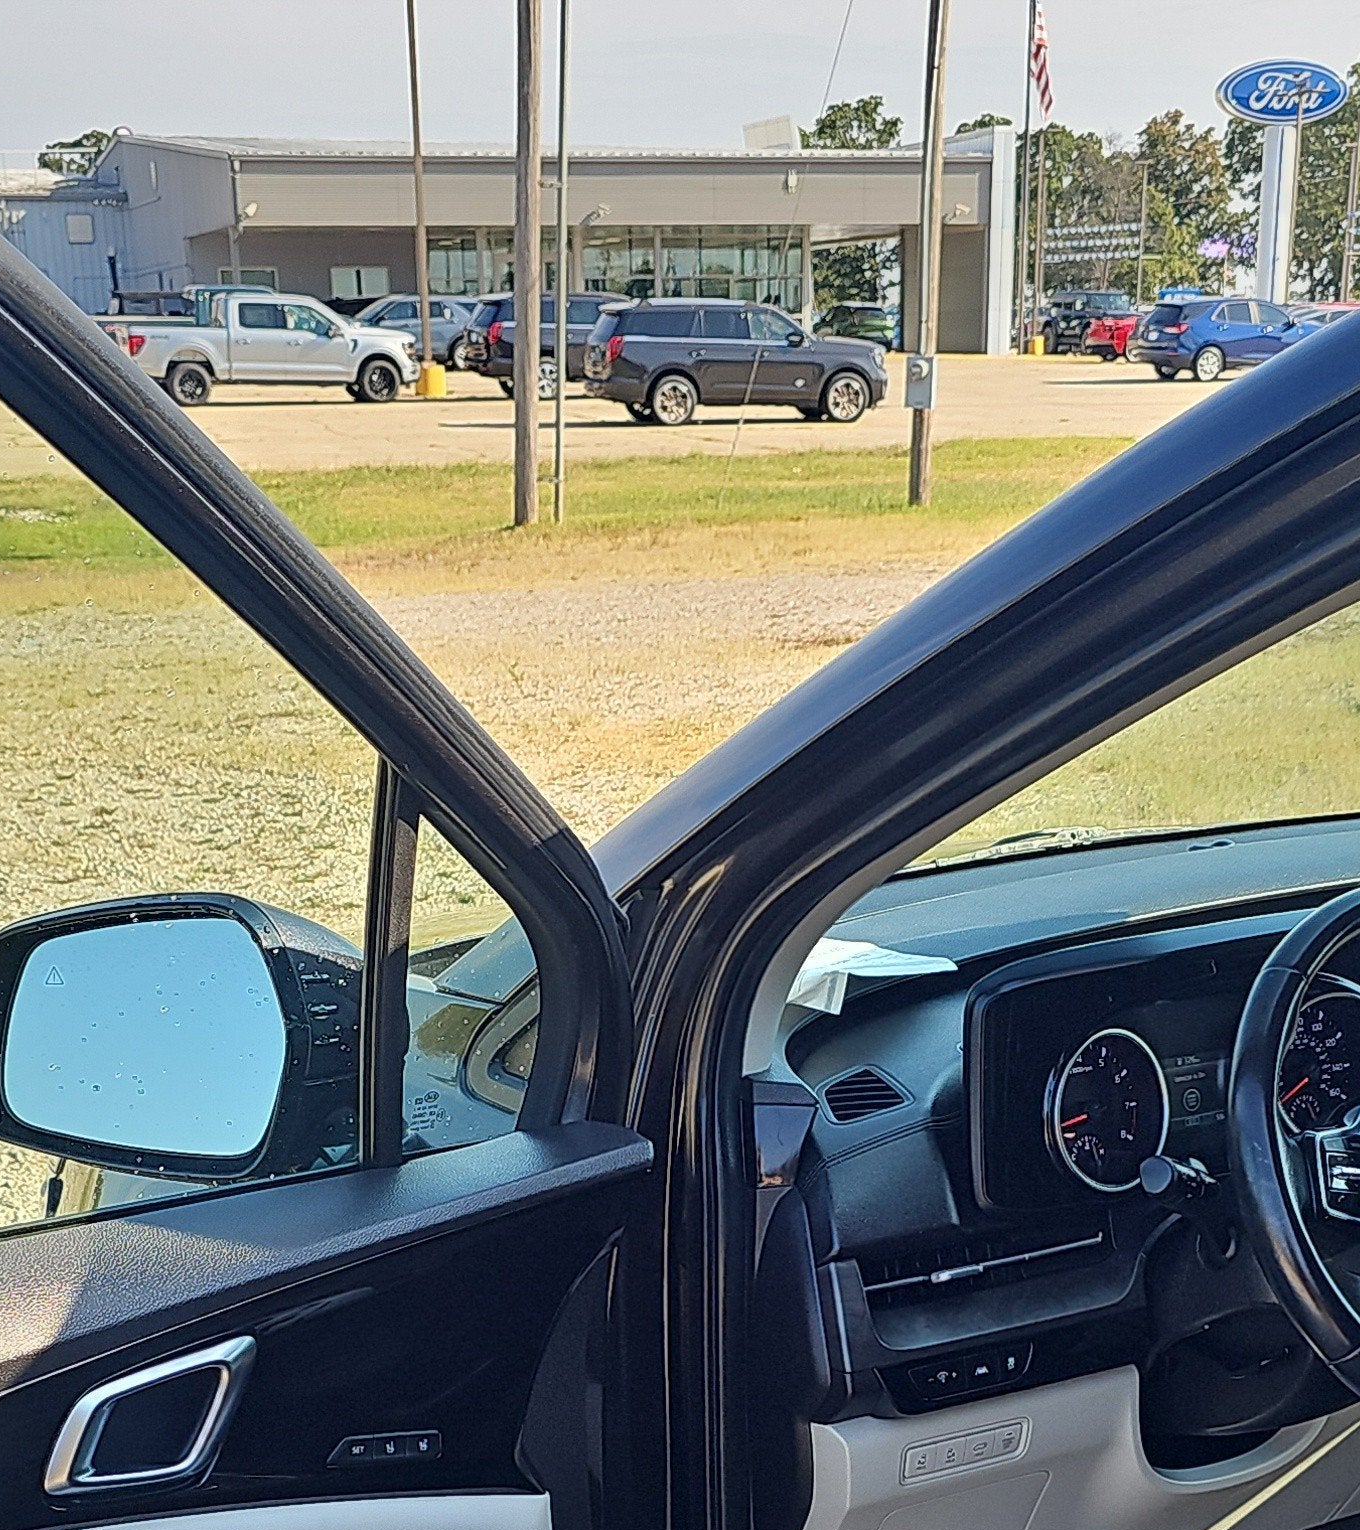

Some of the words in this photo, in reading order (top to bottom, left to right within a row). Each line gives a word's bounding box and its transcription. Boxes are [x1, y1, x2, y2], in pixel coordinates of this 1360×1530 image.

[1248, 71, 1333, 111] Ford
[1098, 1057, 1105, 1067] 5
[1114, 1073, 1122, 1084] 6
